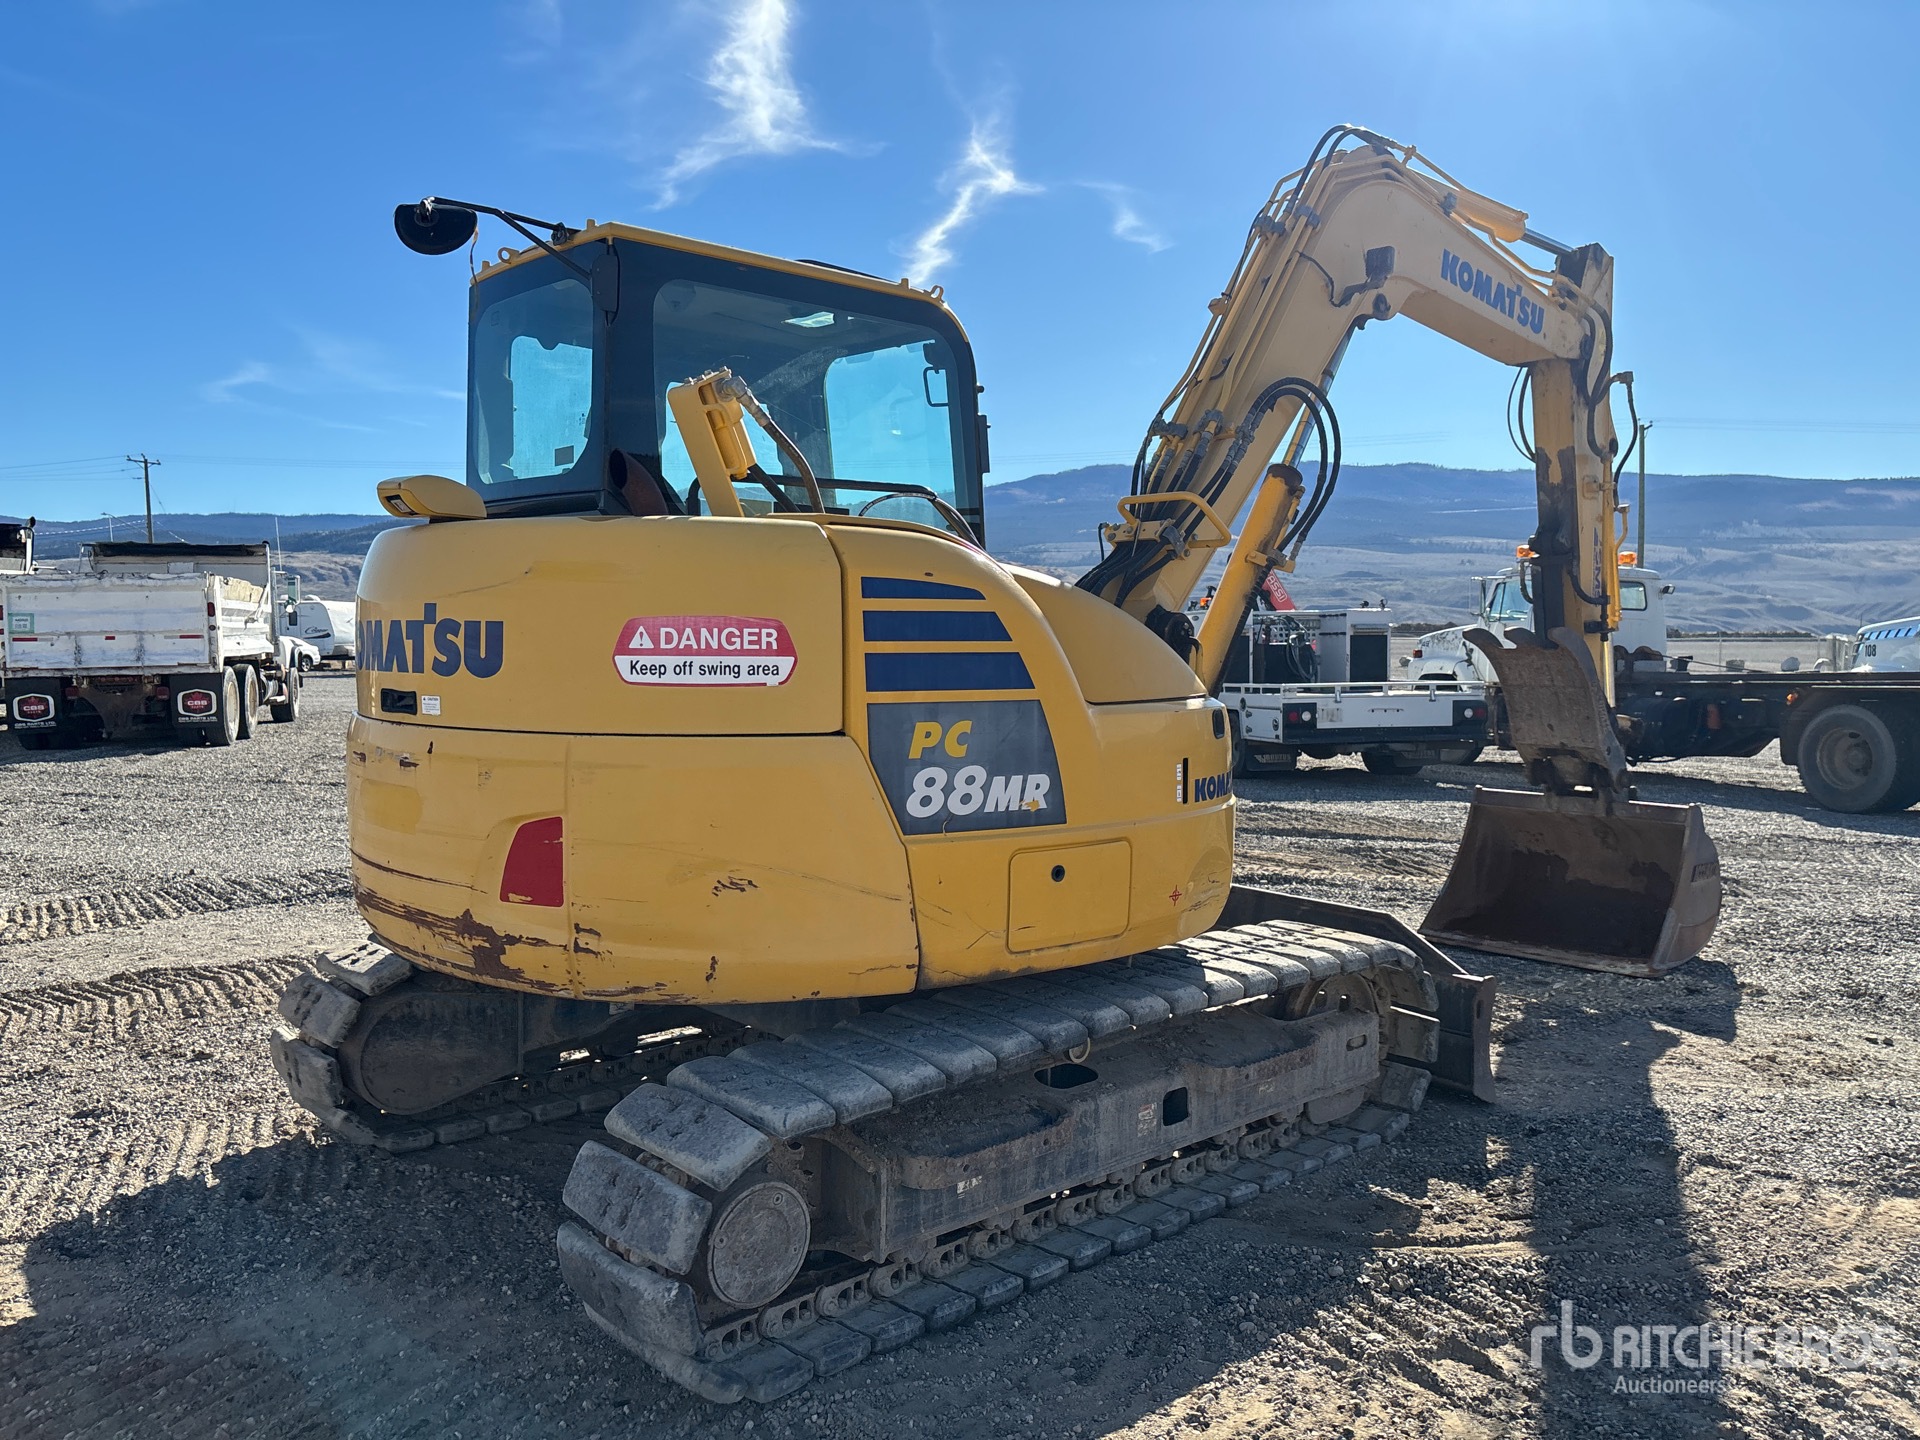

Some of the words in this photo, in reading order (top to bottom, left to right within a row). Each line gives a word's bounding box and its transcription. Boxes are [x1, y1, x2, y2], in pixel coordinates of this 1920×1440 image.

[1441, 248, 1545, 334] KOMATSU
[659, 627, 778, 651] DANGER
[1864, 644, 1877, 657] 108
[629, 660, 667, 679] Keep
[673, 661, 694, 676] off
[698, 661, 741, 679] swing
[747, 664, 780, 676] area
[908, 720, 973, 759] PC
[905, 765, 1051, 818] 88MR
